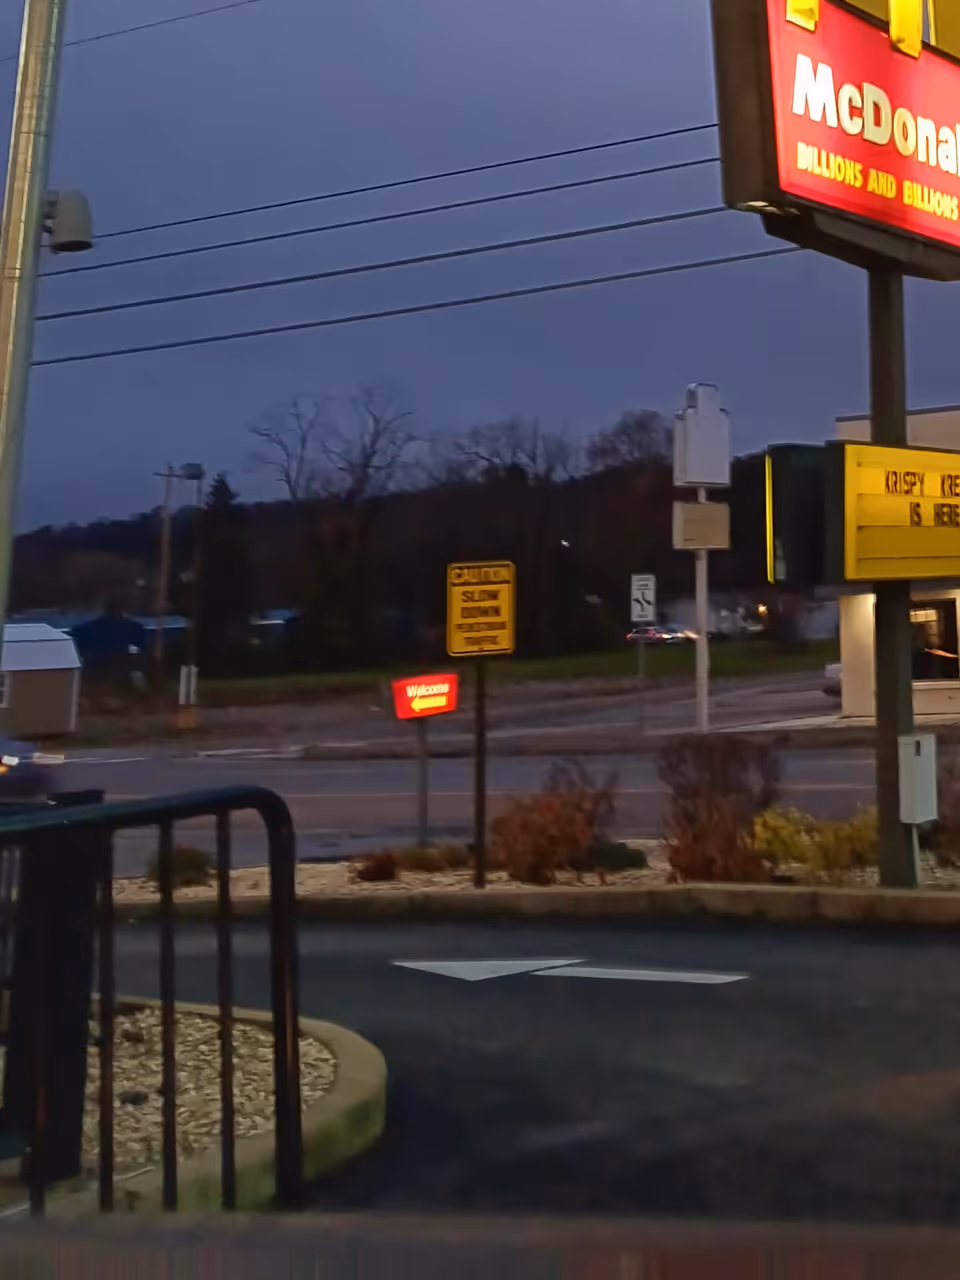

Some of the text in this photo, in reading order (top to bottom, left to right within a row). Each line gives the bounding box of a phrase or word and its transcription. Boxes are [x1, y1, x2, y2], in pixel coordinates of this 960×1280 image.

[796, 141, 864, 189] BILLIONS
[867, 168, 897, 200] AND
[902, 180, 959, 221] BILLIONS
[885, 470, 925, 496] KRISPY
[910, 501, 960, 527] IS HERE
[461, 590, 500, 602] SLOW
[461, 606, 501, 619] DOWN
[406, 683, 450, 697] Welcome
